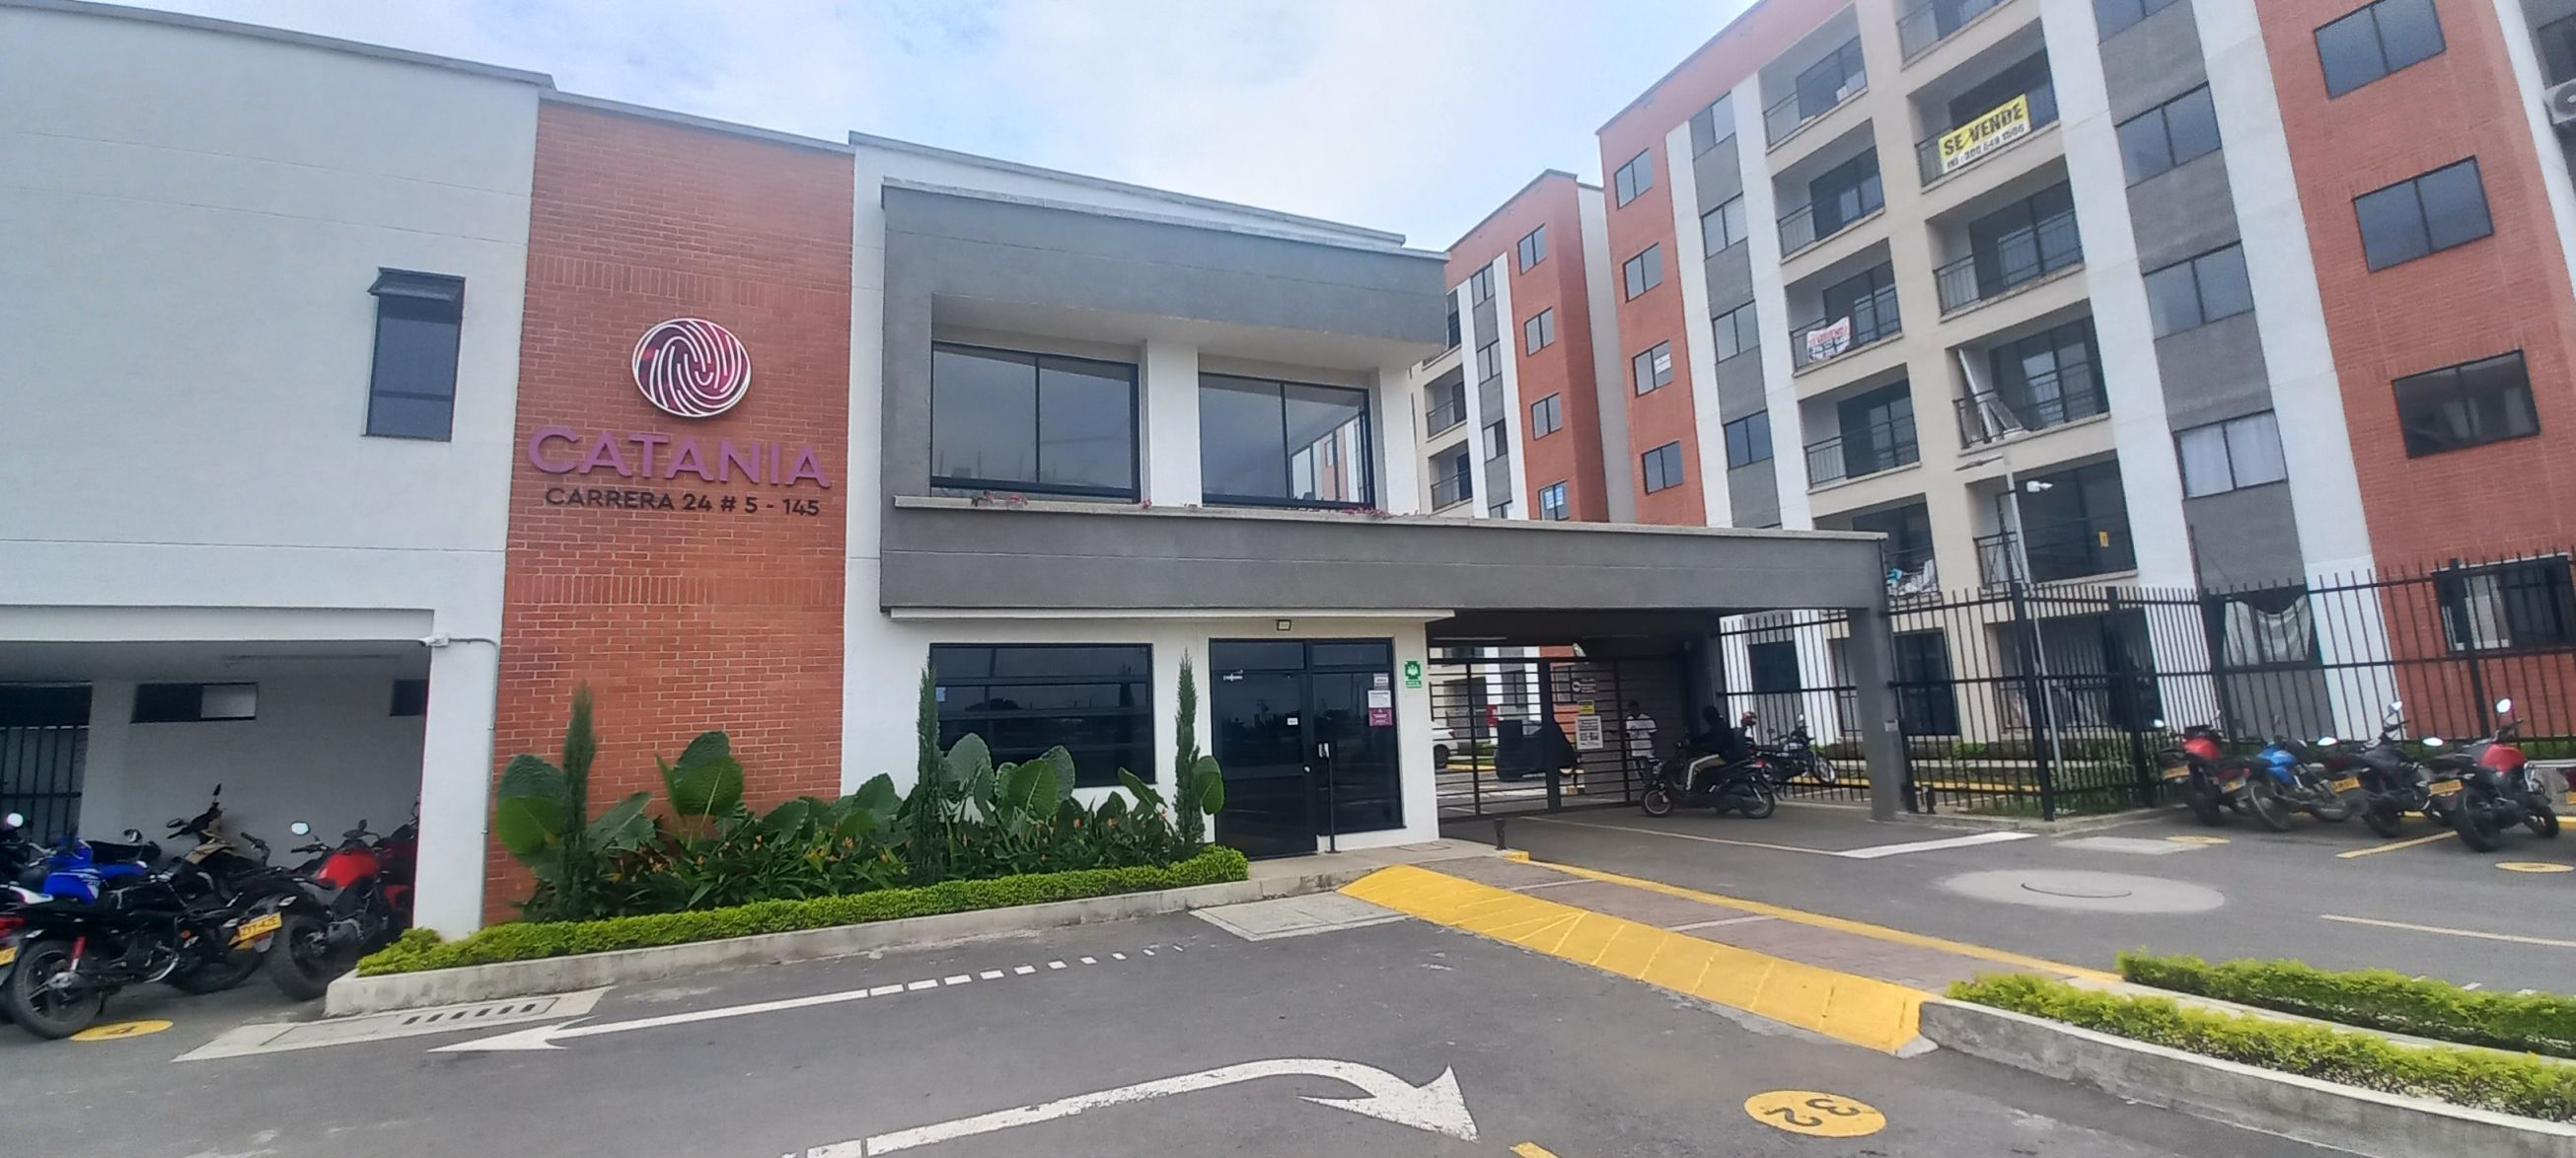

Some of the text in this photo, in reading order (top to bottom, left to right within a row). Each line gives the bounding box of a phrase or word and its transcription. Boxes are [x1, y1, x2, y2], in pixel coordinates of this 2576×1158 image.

[1944, 103, 2023, 156] SE VENDE
[528, 426, 832, 489] CATANIA
[546, 488, 674, 511] CARRERA
[682, 494, 712, 512] 24
[721, 496, 737, 512] #
[744, 496, 760, 514] 5
[782, 498, 820, 516] 145
[1763, 1098, 1861, 1127] 32
